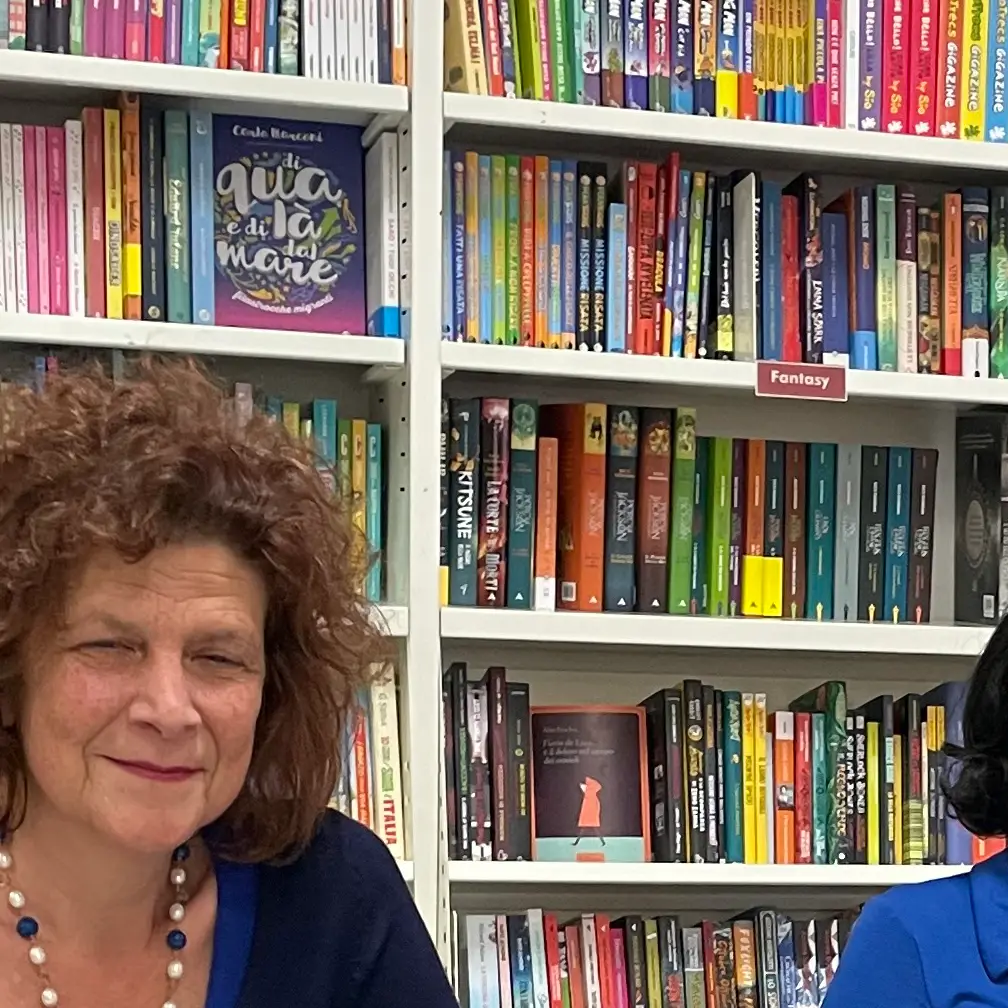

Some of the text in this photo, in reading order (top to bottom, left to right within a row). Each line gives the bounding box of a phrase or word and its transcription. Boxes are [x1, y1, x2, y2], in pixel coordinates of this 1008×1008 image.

[863, 76, 873, 86] by
[863, 89, 876, 109] Sio
[889, 80, 899, 91] by
[917, 81, 928, 92] by
[889, 94, 902, 114] Sio
[917, 95, 929, 115] Sio
[232, 124, 323, 143] Carlo Marconi
[282, 153, 300, 169] di
[216, 162, 343, 215] qua
[227, 199, 322, 240] e di là
[216, 240, 338, 285] mare
[284, 239, 318, 261] dal
[579, 238, 590, 332] MISSIONE RISATA
[594, 239, 605, 332] MISSIONE RISATA
[655, 250, 664, 292] DRACULA
[770, 369, 830, 391] Fantasy
[456, 470, 475, 539] KITSUNE
[485, 497, 500, 533] CORTE
[615, 491, 628, 542] JACKSON
[484, 553, 500, 590] MORTI
[856, 734, 866, 779] SHERLOCK
[739, 928, 753, 986] FOXLIGHT
